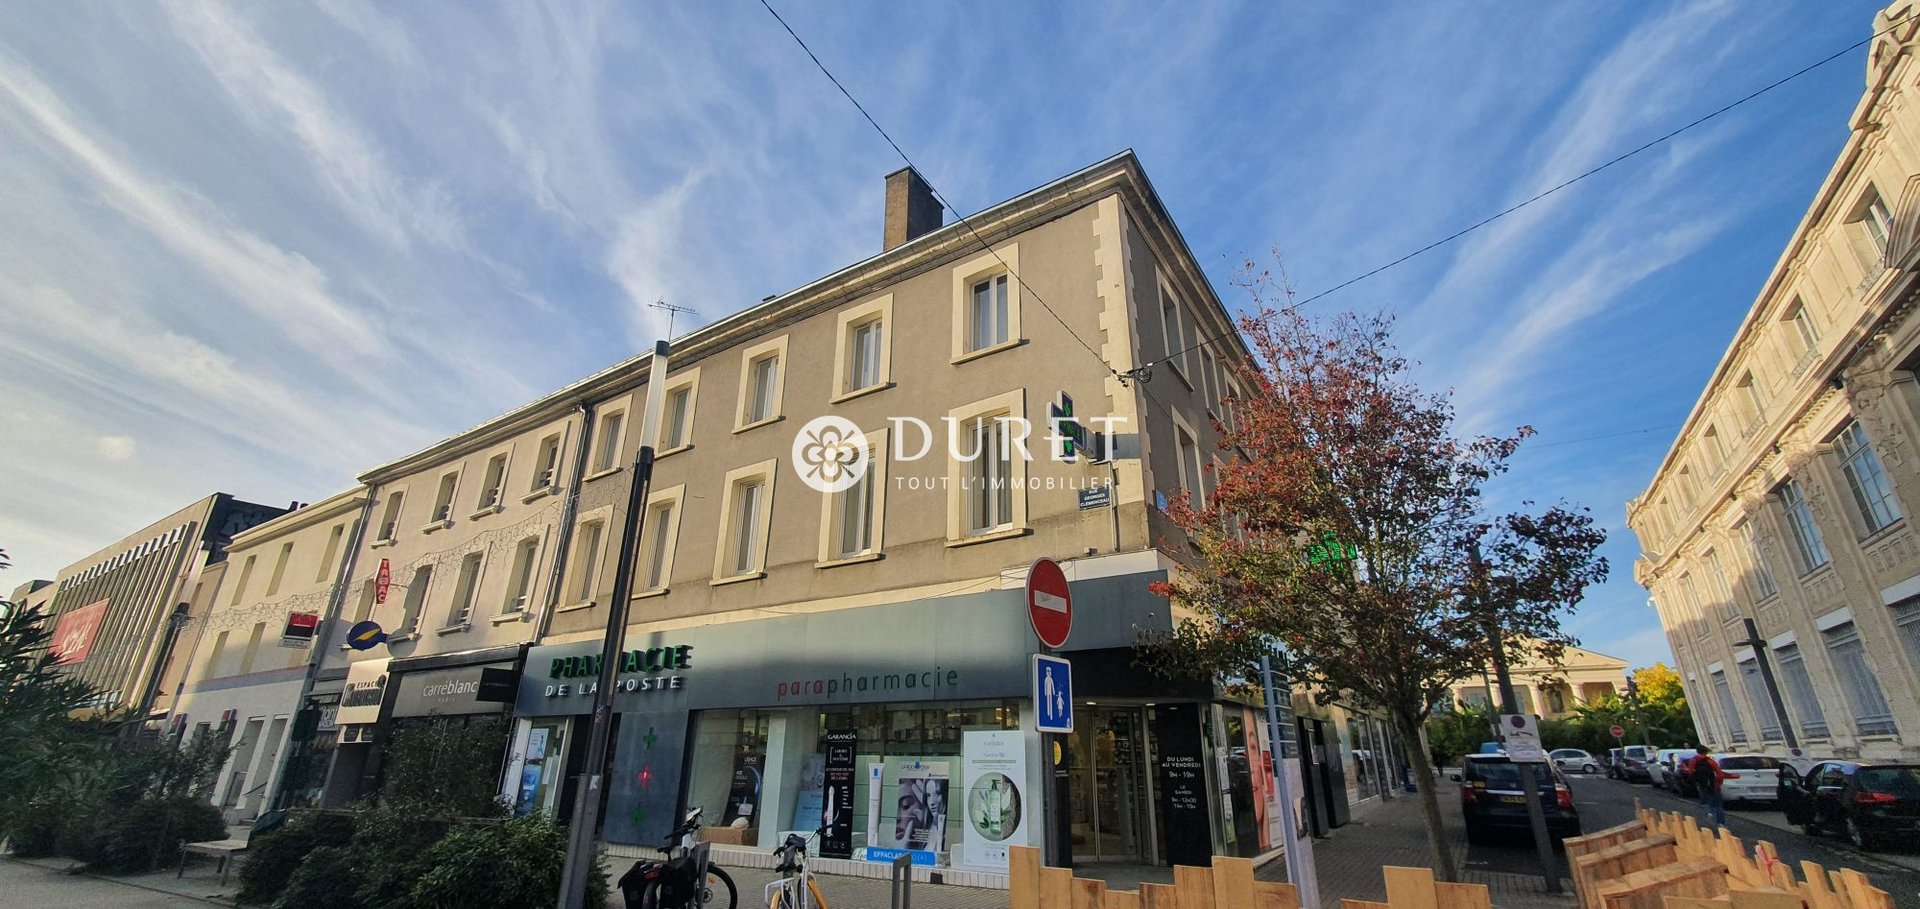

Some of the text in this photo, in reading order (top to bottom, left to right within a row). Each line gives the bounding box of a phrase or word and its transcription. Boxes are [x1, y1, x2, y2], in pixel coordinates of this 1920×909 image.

[1080, 498, 1110, 506] CLEMENCEAU
[378, 560, 390, 601] TABAC
[550, 645, 694, 678] PHARACIE
[422, 680, 478, 697] carréblanc
[545, 684, 568, 697] DE
[578, 682, 598, 695] LA
[778, 667, 958, 700] parapharmacie
